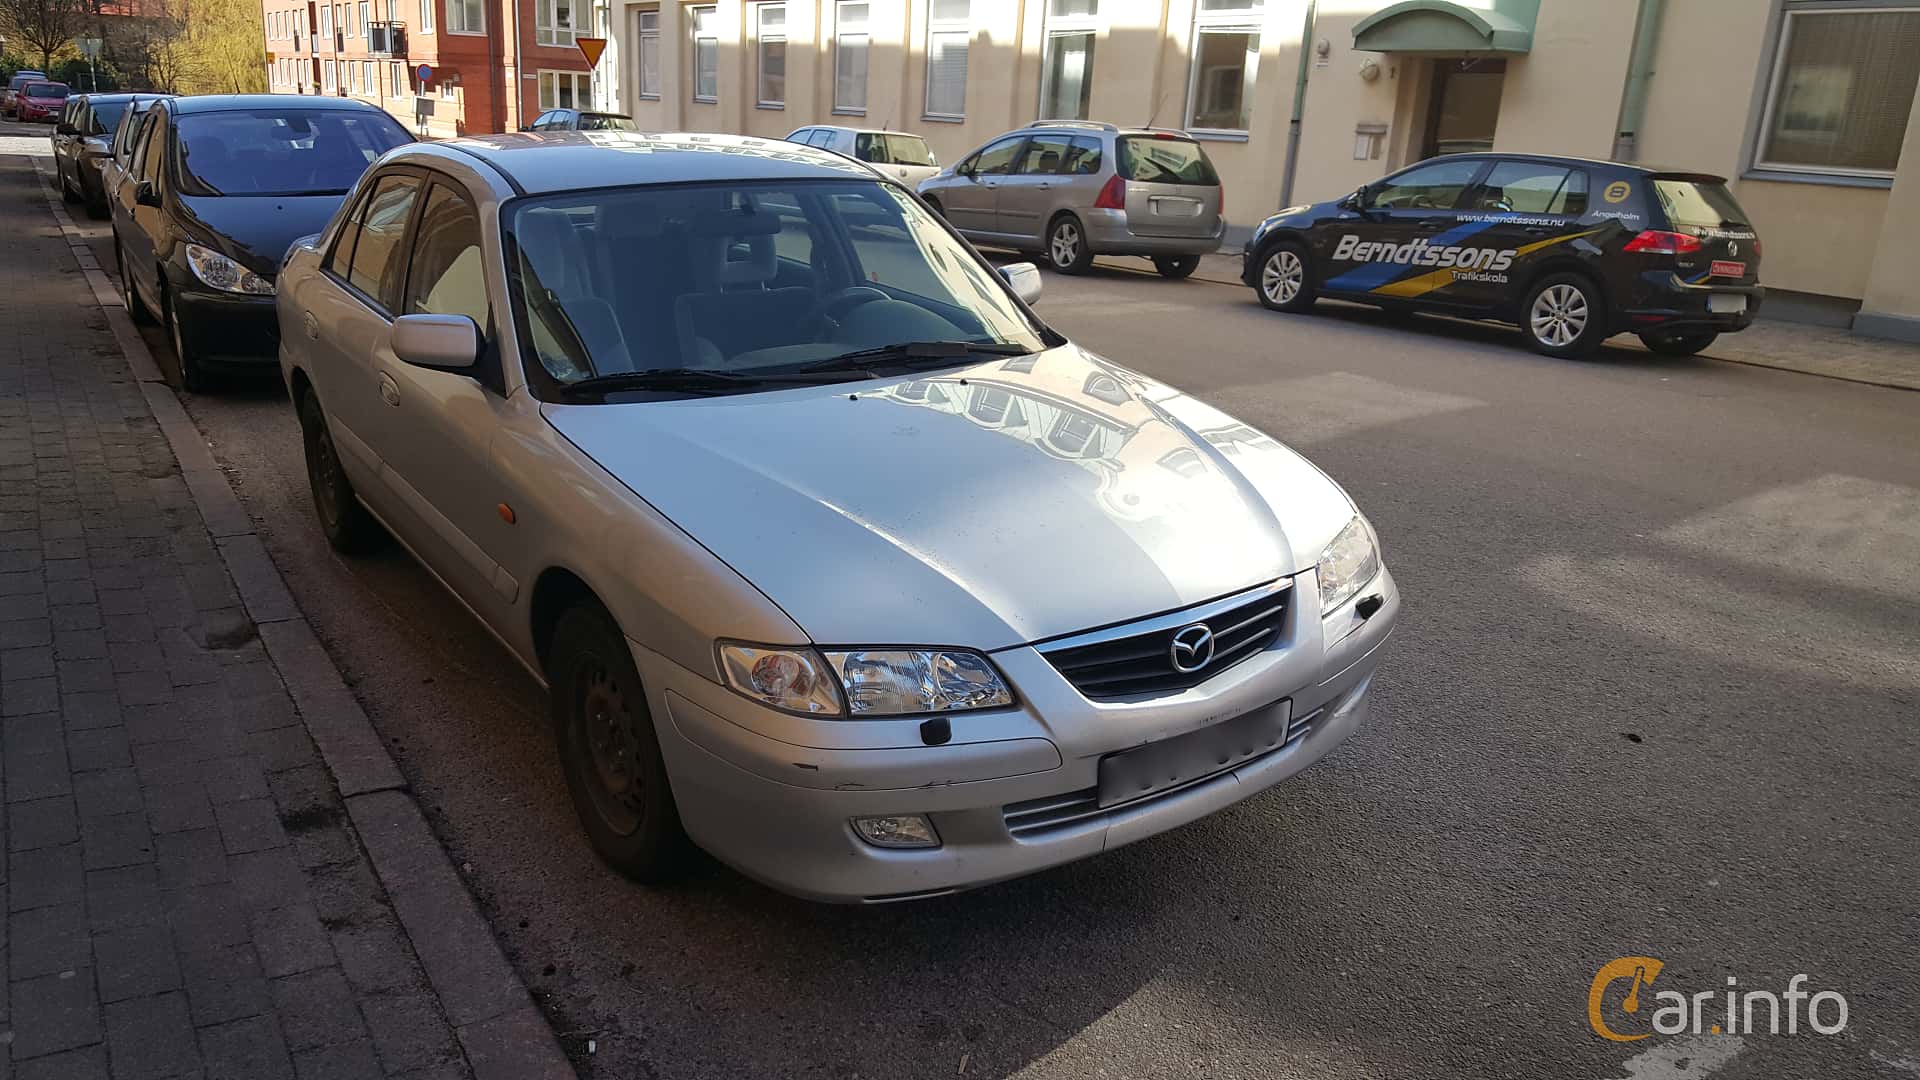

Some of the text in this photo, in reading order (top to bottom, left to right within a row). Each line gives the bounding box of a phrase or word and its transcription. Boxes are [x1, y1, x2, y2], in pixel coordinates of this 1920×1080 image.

[1456, 214, 1565, 227] www.berndtssons.nu
[1332, 234, 1518, 272] Berndtssons
[1451, 270, 1508, 284] Trafikskola
